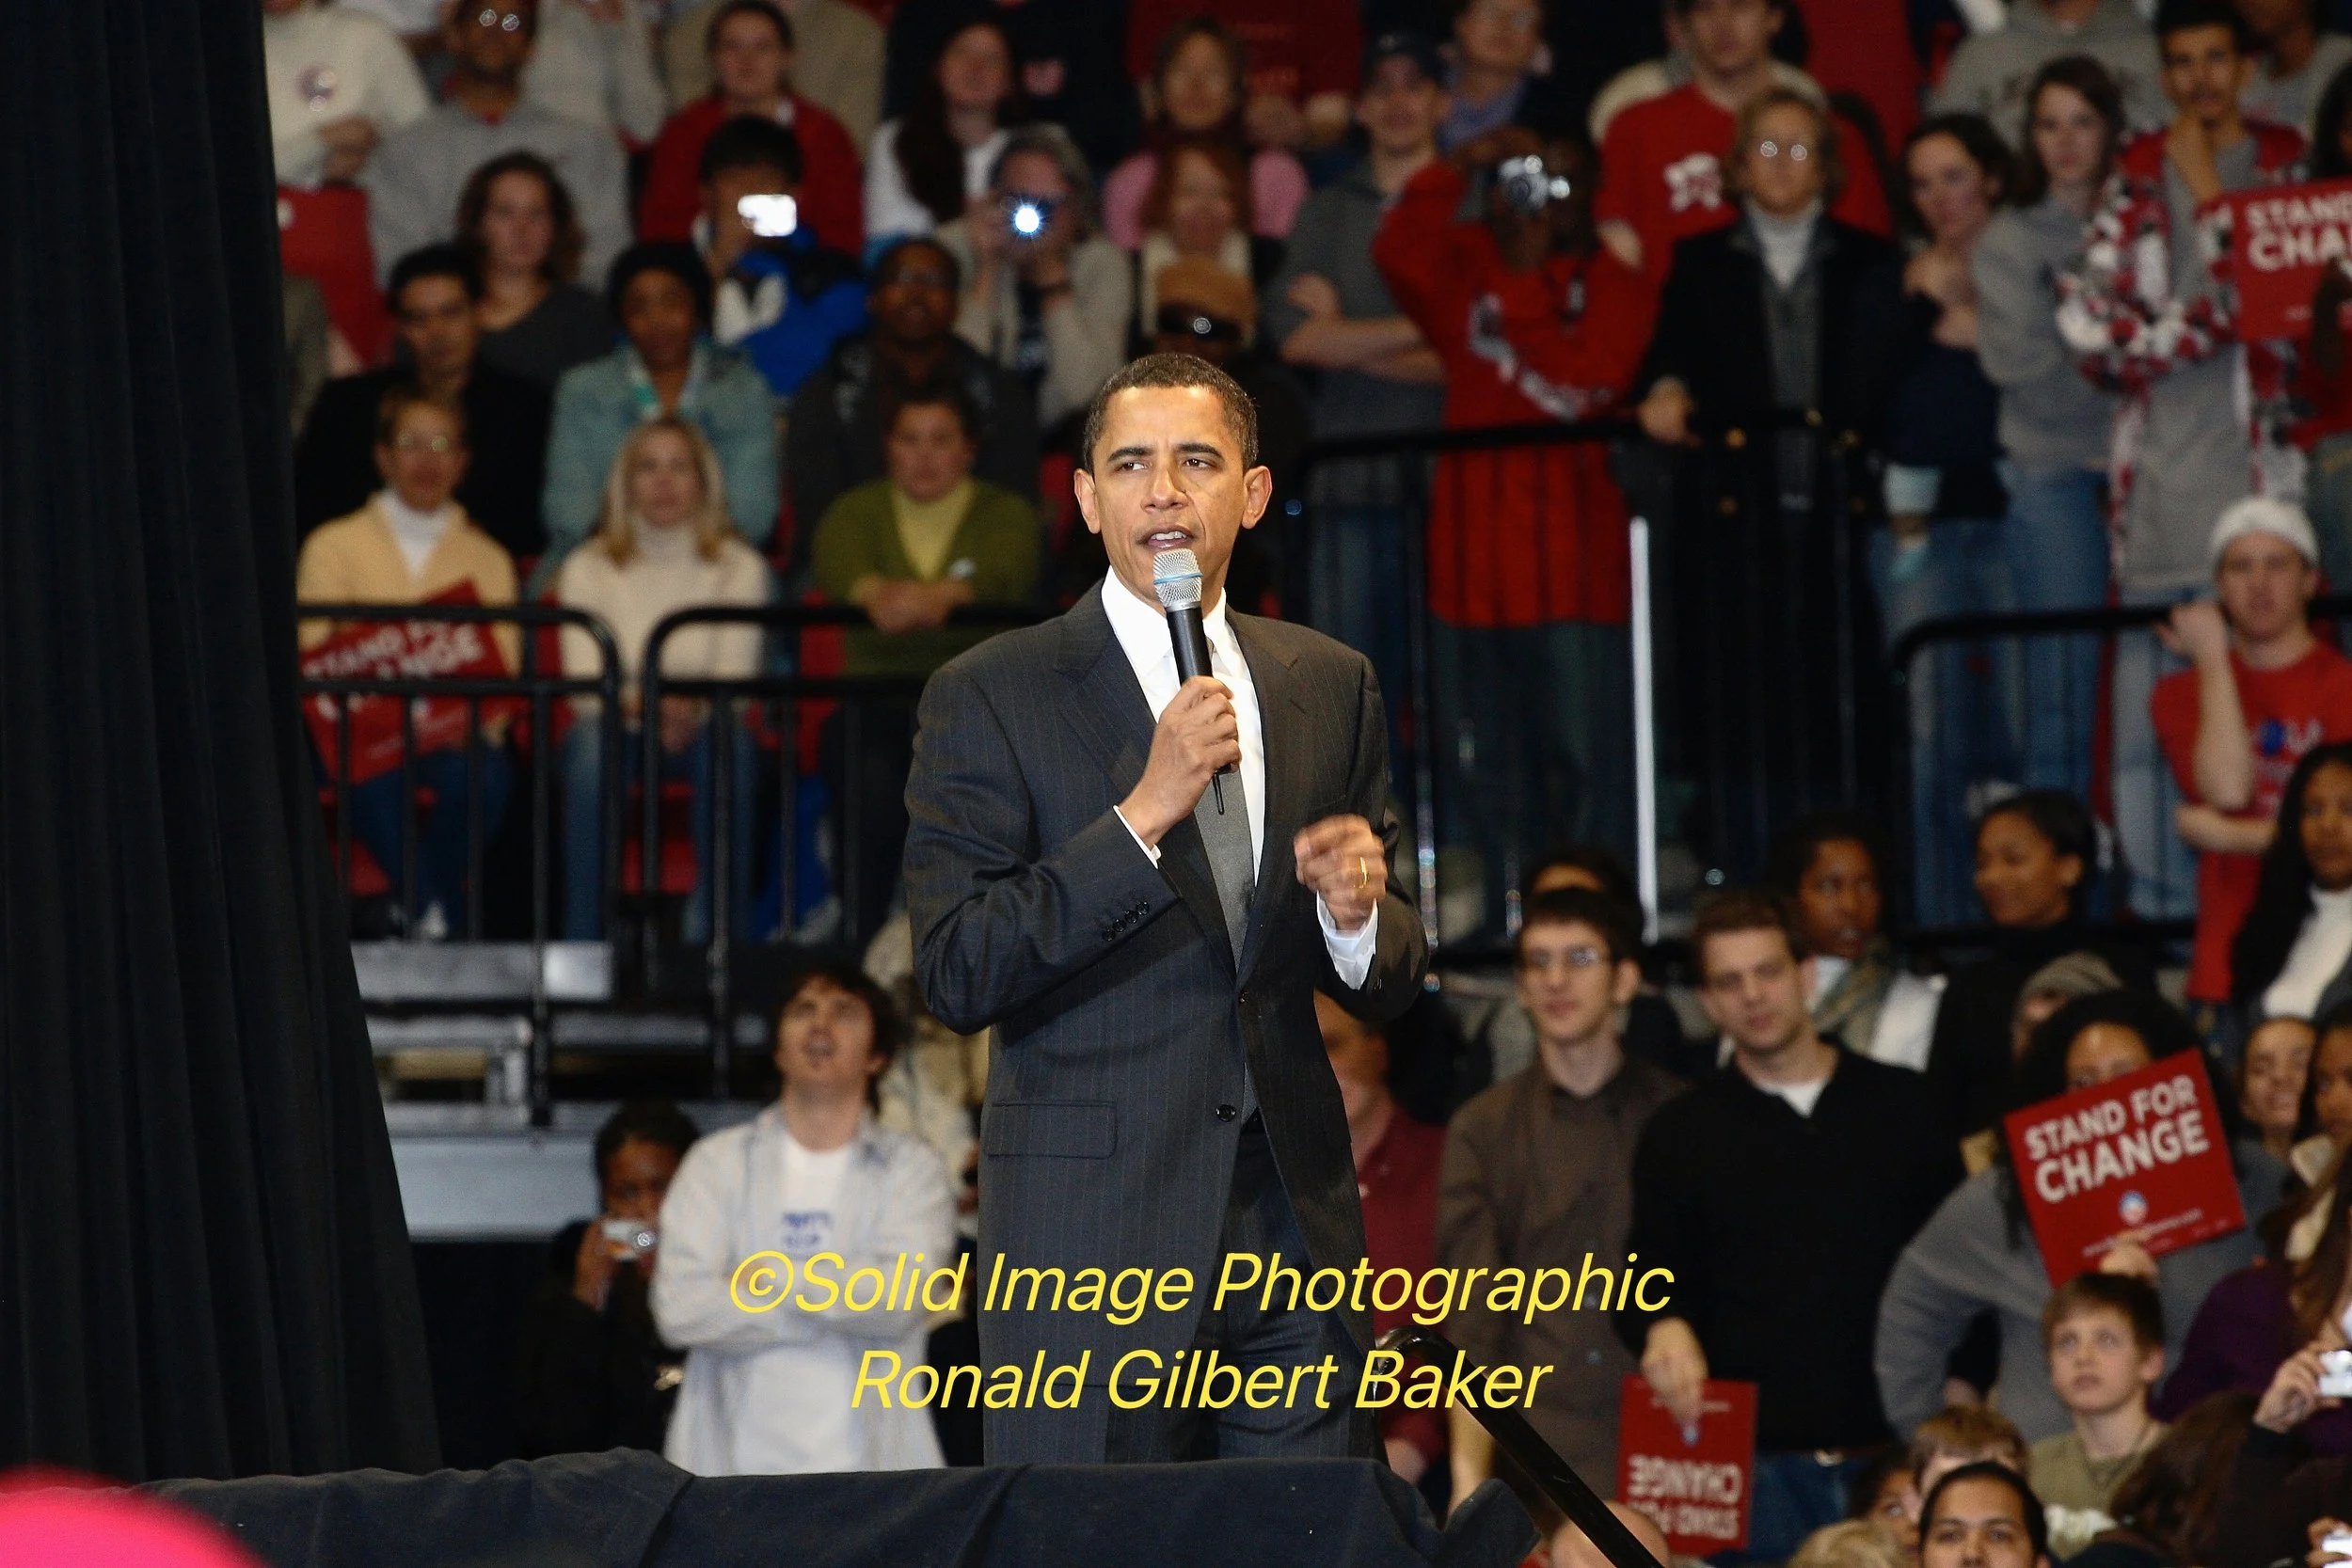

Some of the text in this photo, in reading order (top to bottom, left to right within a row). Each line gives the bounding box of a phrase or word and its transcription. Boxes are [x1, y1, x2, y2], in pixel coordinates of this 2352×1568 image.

[2247, 226, 2352, 271] CHA
[2025, 1074, 2197, 1162] STAND FOR
[2034, 1109, 2211, 1204] CHANGE
[1627, 1454, 1742, 1505] CHANGE
